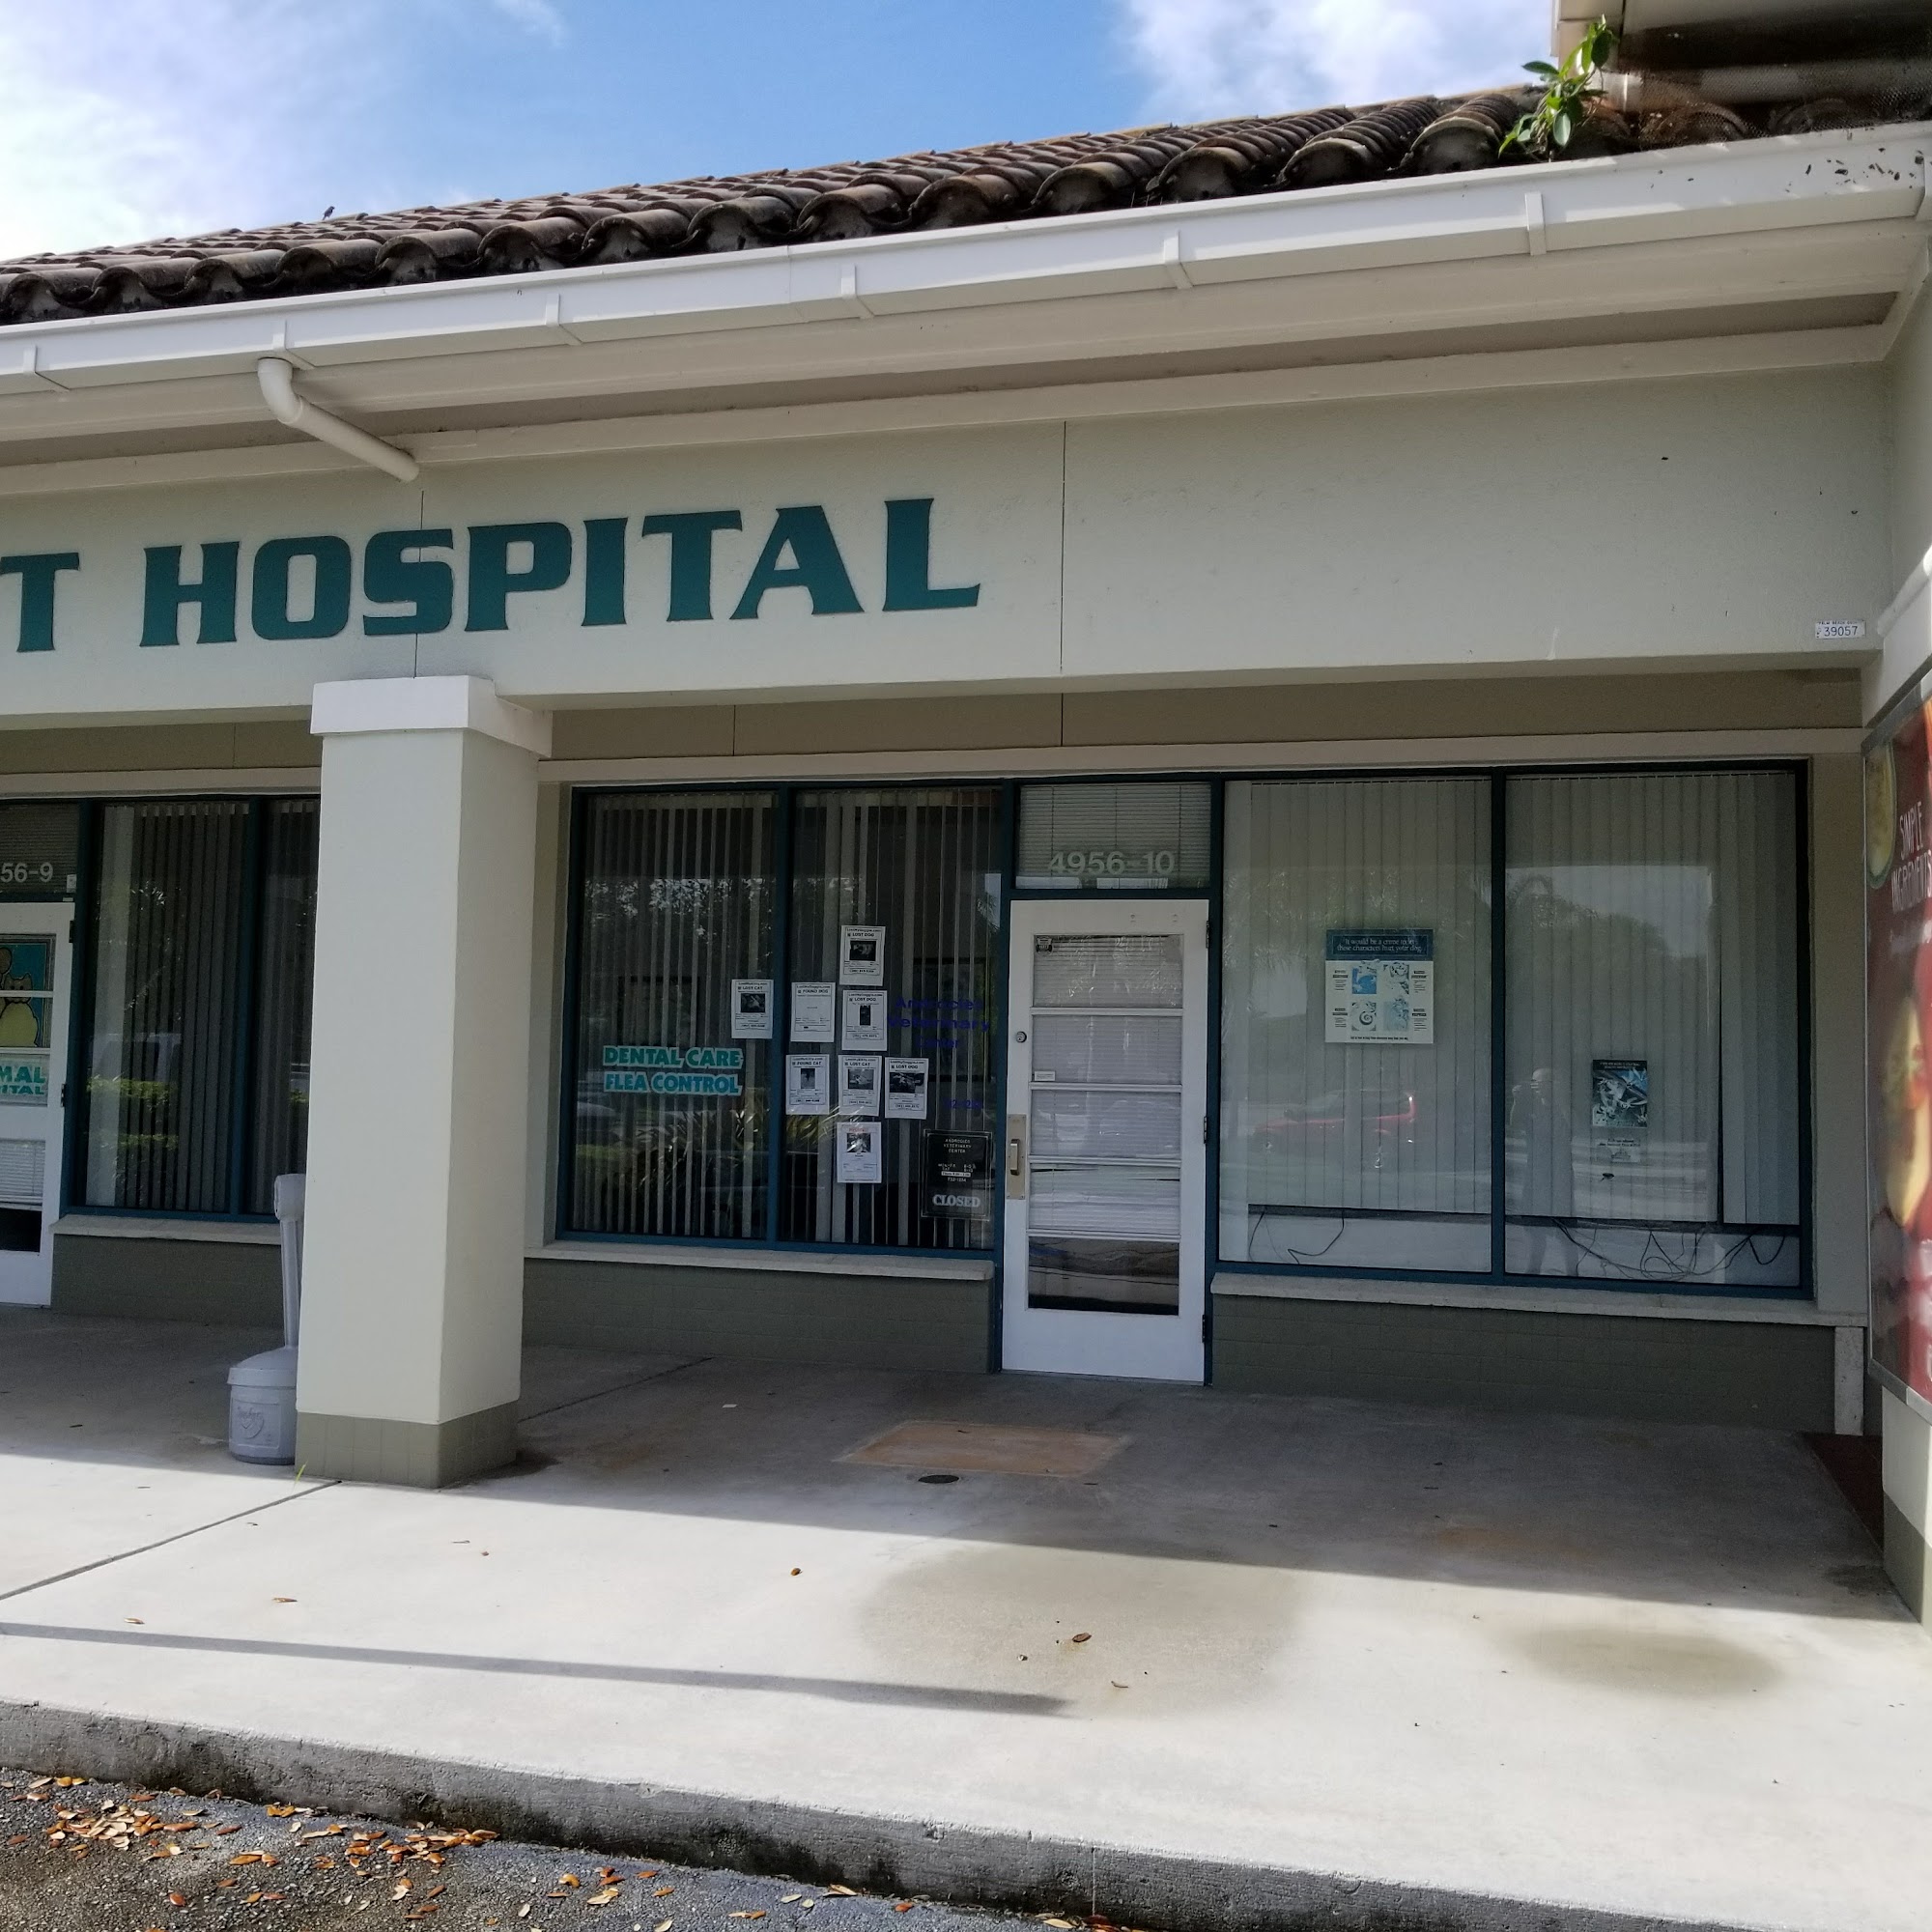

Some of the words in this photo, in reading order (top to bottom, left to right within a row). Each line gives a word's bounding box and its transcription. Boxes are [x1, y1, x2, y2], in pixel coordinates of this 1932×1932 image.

[0, 553, 79, 652] T
[140, 497, 980, 647] HOSPITAL
[1824, 626, 1858, 637] 39057
[1899, 801, 1923, 860] SIMPLE
[0, 862, 53, 883] 56-9
[1047, 850, 1175, 875] 4956-10
[604, 1047, 682, 1066] DENTAL
[687, 1048, 742, 1067] CARE
[0, 1085, 44, 1094] ITAL
[605, 1073, 648, 1092] FLEA
[652, 1074, 741, 1094] CONTROL
[932, 1194, 980, 1208] CLOSED
